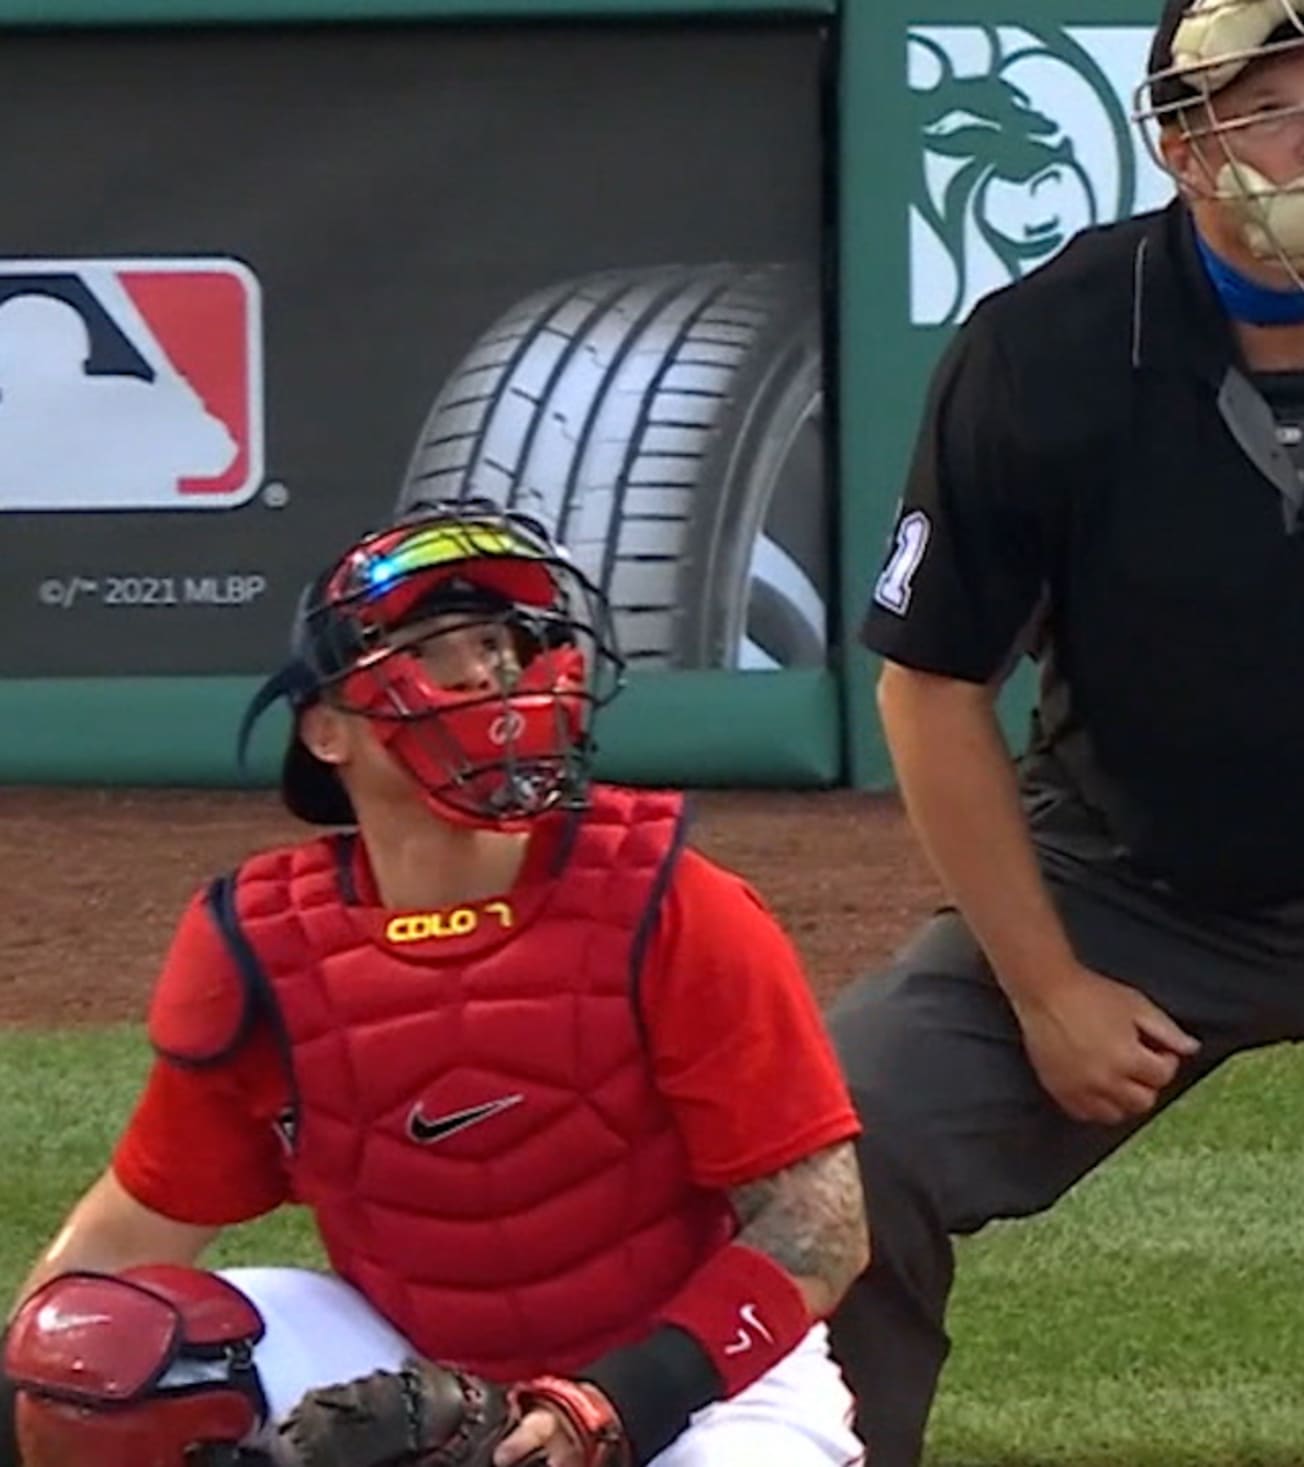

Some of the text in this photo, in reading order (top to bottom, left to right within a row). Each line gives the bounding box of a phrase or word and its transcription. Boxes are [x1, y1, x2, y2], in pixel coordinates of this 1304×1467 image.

[104, 577, 177, 603] 2021
[184, 574, 267, 602] MLBP
[485, 901, 512, 928] 7
